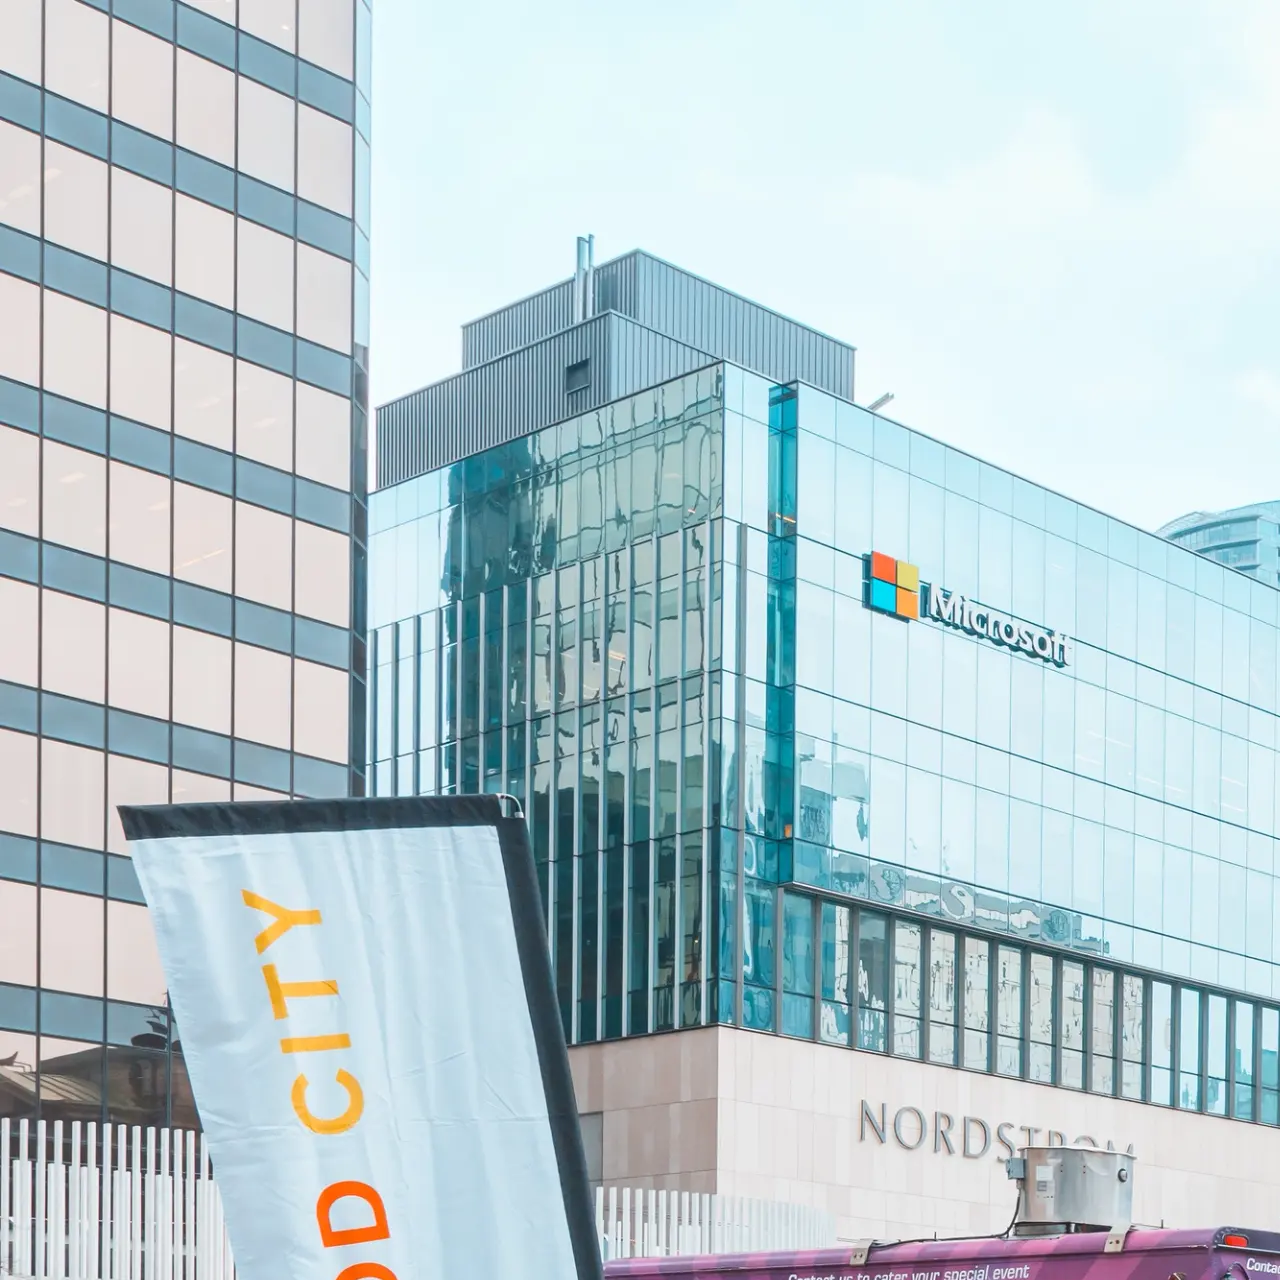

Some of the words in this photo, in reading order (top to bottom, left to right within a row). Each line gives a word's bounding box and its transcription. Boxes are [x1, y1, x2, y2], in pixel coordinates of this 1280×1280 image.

[930, 582, 1072, 666] Microsoft
[241, 889, 364, 1135] CITY
[860, 1099, 1134, 1163] NORDST
[992, 1265, 1030, 1280] event
